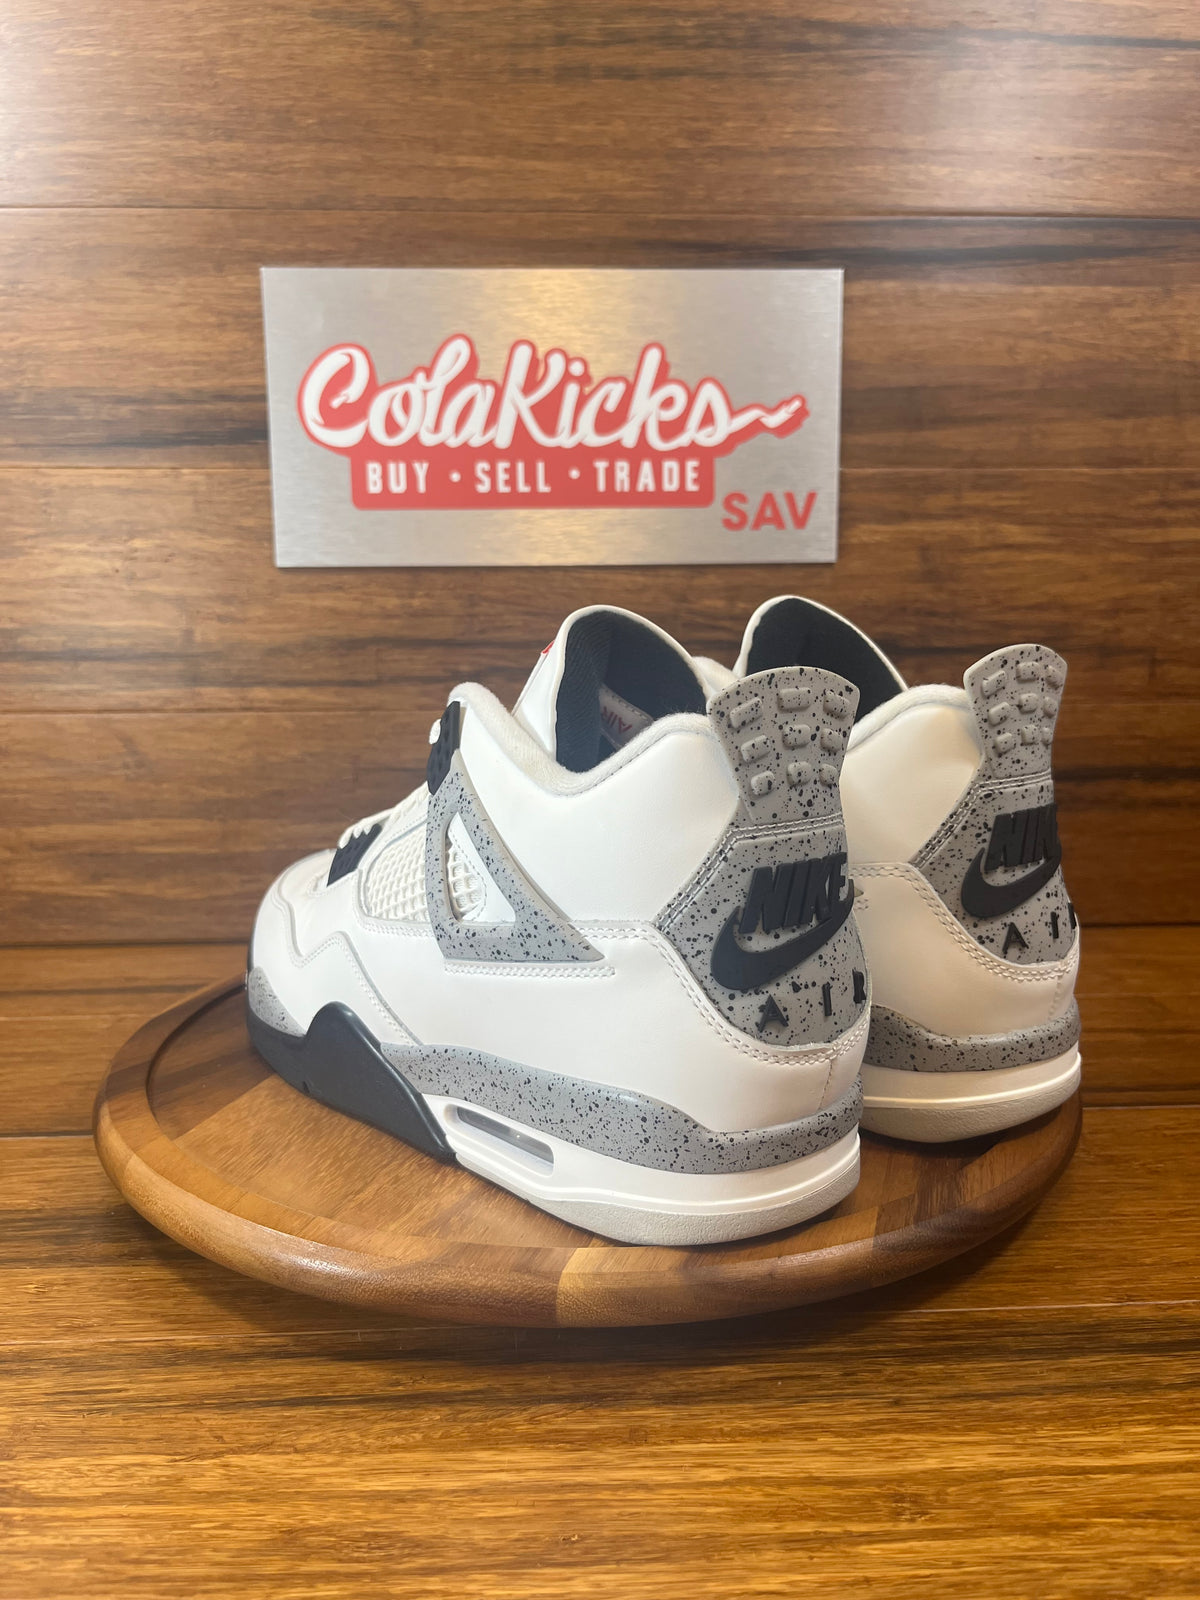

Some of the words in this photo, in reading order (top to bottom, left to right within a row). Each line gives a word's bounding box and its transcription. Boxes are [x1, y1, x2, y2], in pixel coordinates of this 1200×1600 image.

[300, 334, 804, 452] ColaKicks
[366, 461, 430, 495] BUY
[474, 461, 552, 494] SELL
[593, 459, 701, 494] TRADE
[721, 491, 818, 531] SAV
[739, 852, 848, 934] NIKE
